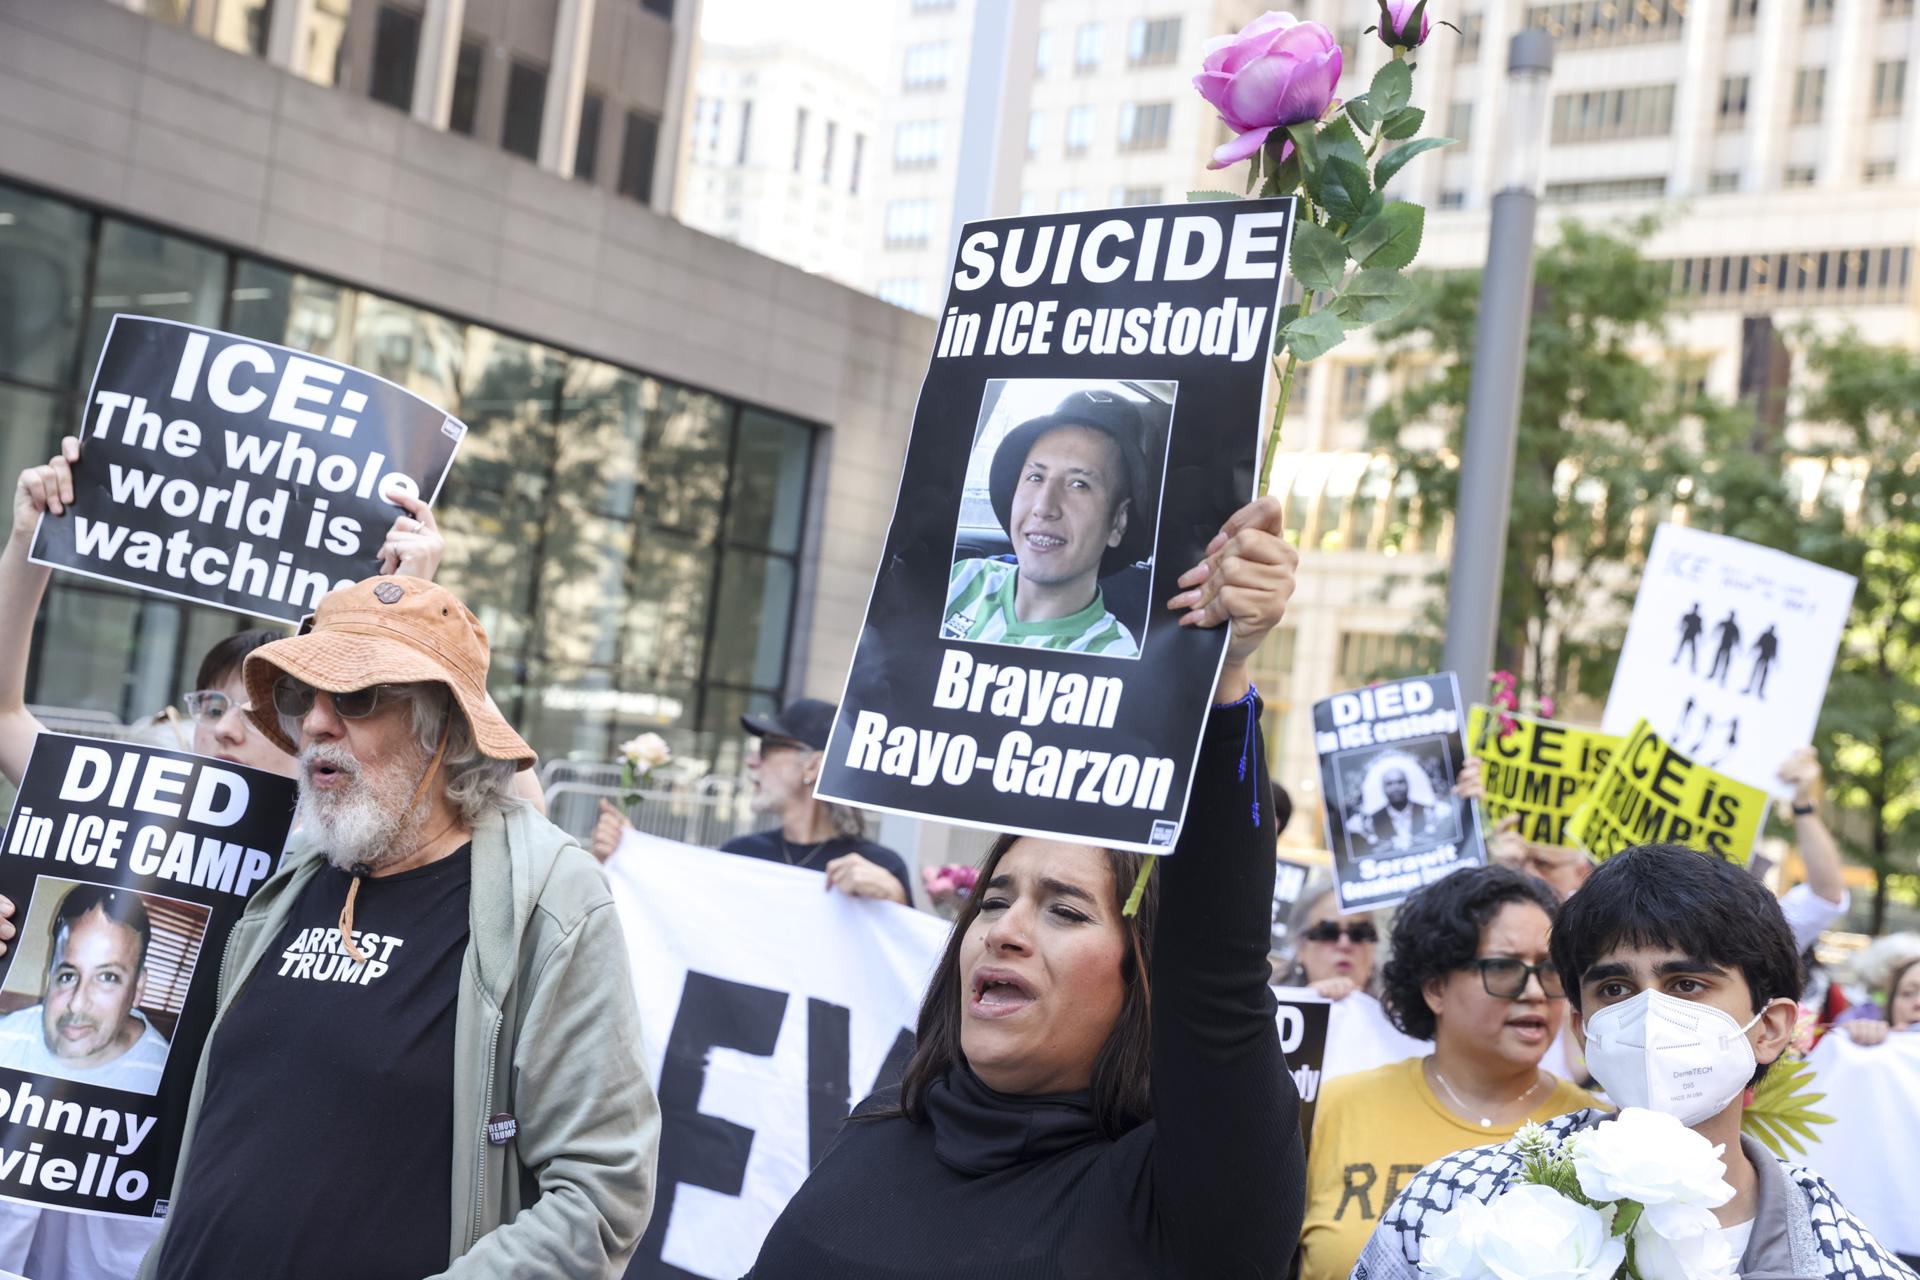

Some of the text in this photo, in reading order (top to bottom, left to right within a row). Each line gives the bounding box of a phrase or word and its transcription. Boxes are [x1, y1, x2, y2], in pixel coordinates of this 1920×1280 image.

[954, 211, 1284, 291] SUICIDE
[937, 297, 1267, 362] in ICE custody
[170, 333, 368, 438] ICE:
[93, 390, 420, 505] The whole
[109, 464, 362, 556] world is
[74, 516, 357, 611] watchin
[932, 648, 1124, 728] Brayan
[1331, 681, 1434, 726] DIED
[59, 745, 251, 828] DIED
[845, 710, 1175, 811] Rayo-Garzon
[1622, 719, 1692, 806] ICE
[8, 807, 272, 898] in ICE CAMP
[277, 951, 389, 986] TRUMP
[286, 927, 404, 963] ARREST
[488, 1119, 517, 1133] REMOVE
[490, 1128, 517, 1141] TRUMP
